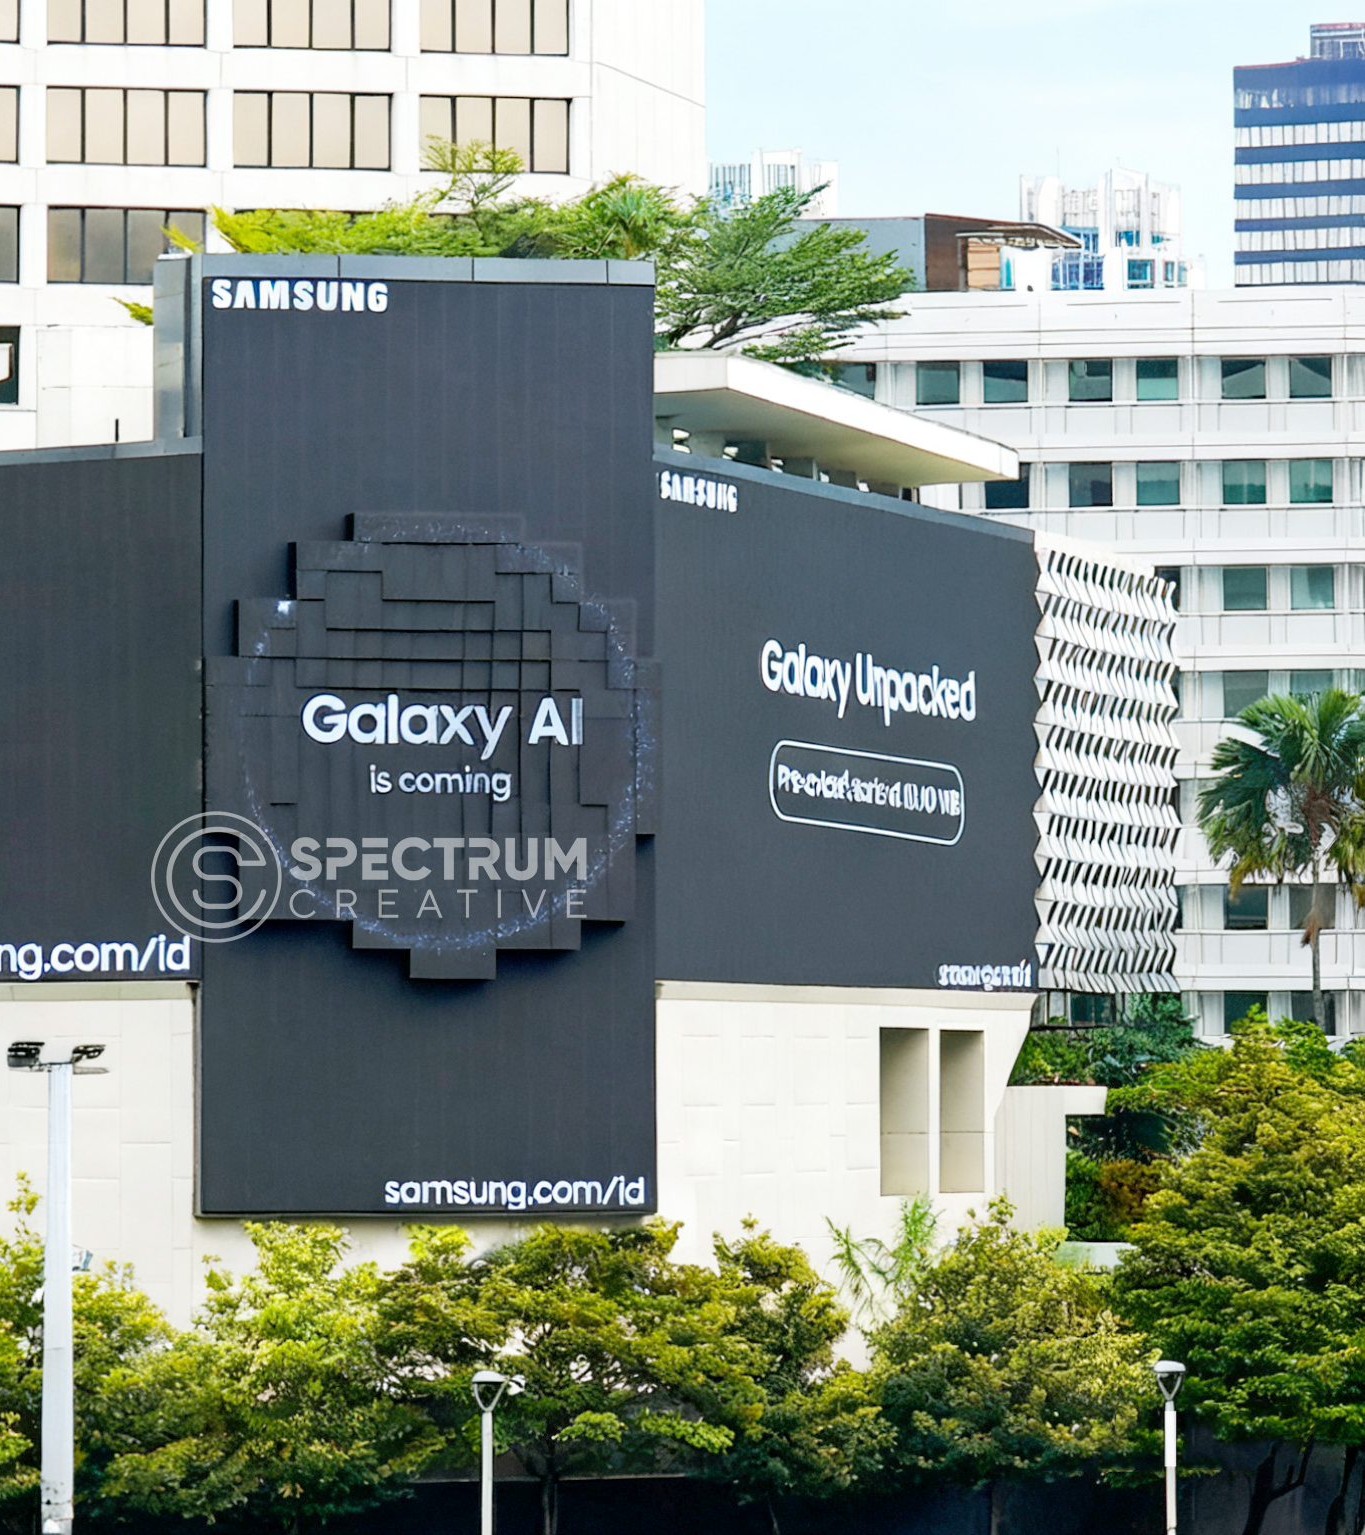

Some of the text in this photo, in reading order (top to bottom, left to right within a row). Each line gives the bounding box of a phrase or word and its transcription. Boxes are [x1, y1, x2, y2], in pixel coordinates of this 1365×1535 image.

[211, 279, 389, 313] SAMSUNG
[761, 639, 977, 727] Galaxy Unpacked
[302, 693, 584, 761] Galaxy AI
[369, 763, 512, 803] is coming
[384, 1175, 645, 1211] samsung.com/id
